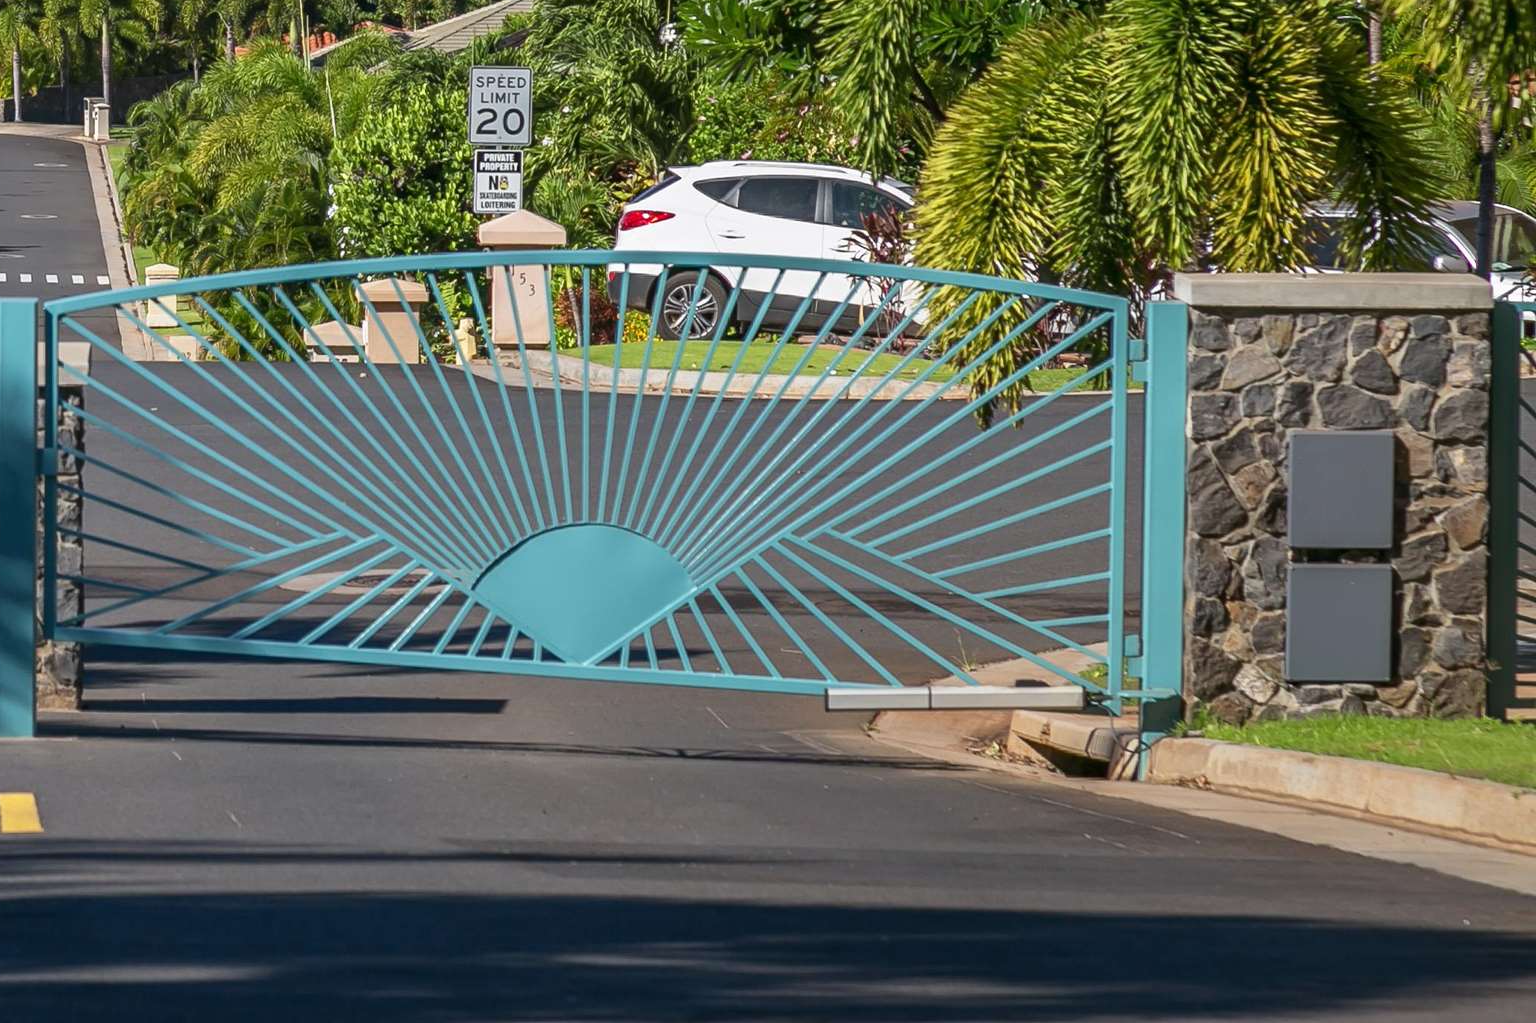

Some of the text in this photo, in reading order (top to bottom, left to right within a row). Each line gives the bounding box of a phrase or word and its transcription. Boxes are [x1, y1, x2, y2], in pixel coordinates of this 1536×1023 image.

[476, 76, 527, 88] SPEED
[480, 92, 521, 104] LIMIT
[475, 108, 525, 135] 20
[484, 153, 515, 162] PRIVATE
[480, 162, 519, 171] PROPERTY
[480, 201, 516, 209] LOITERING
